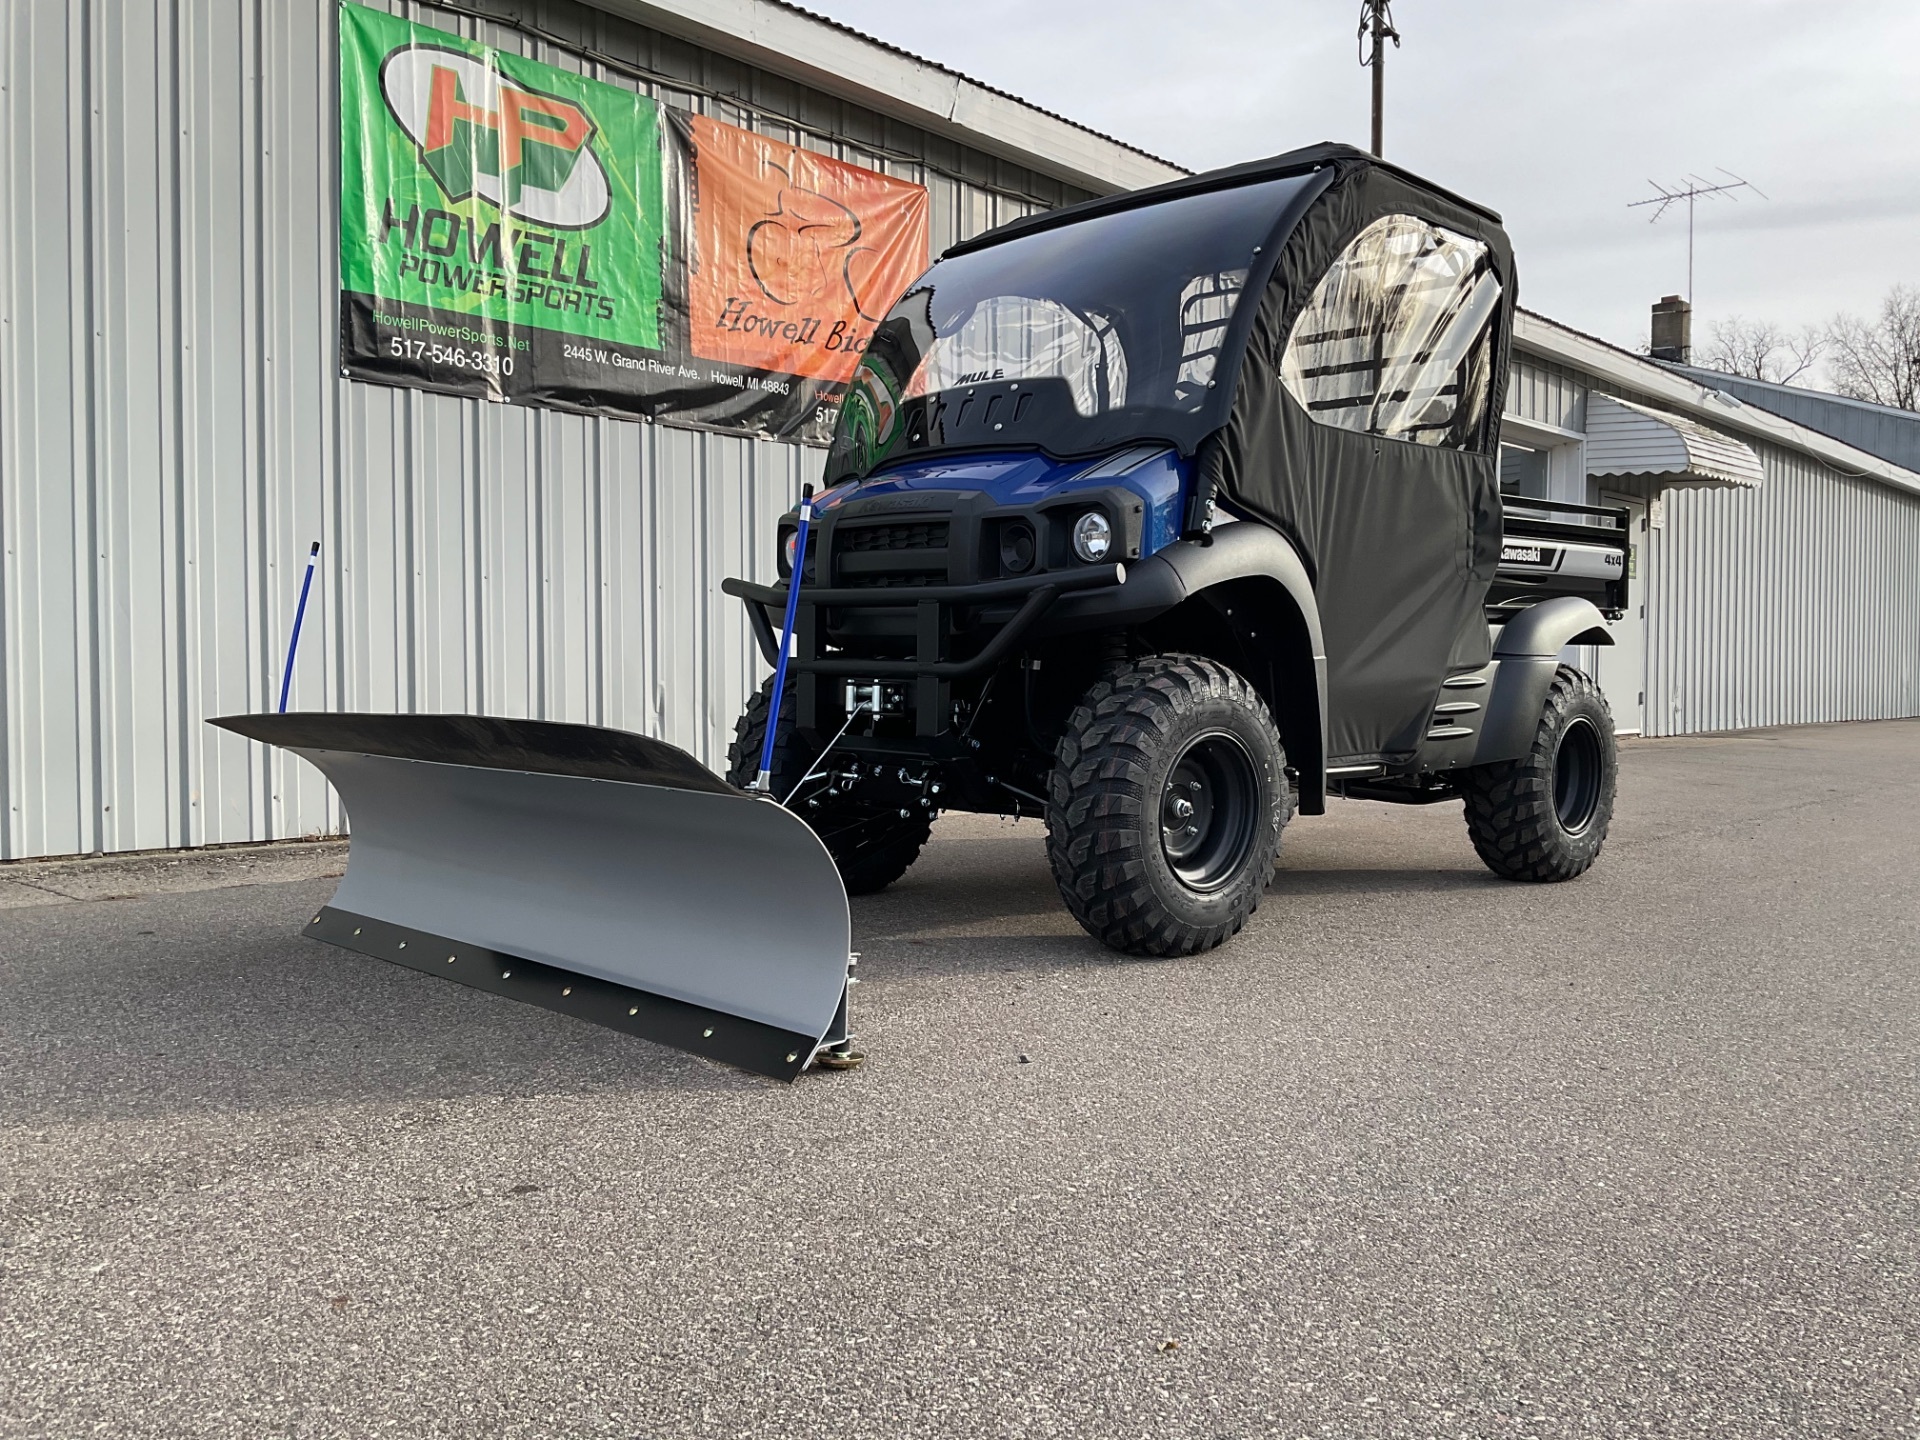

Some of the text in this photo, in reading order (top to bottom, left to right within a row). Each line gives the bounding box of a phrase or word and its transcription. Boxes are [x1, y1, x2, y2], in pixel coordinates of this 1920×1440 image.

[378, 197, 598, 290] HOWELL
[399, 253, 616, 320] POWERSPORTS
[372, 309, 530, 352] HowellPowerSports.Net
[716, 296, 822, 345] Howell
[390, 336, 514, 376] 517-546-3310
[563, 344, 790, 396] 2445 W. Grand River Ave. Howell, MI 48843
[954, 368, 1004, 386] MULE
[815, 406, 838, 424] 517
[1501, 546, 1541, 563] awasaki
[1604, 554, 1622, 568] 4x4
